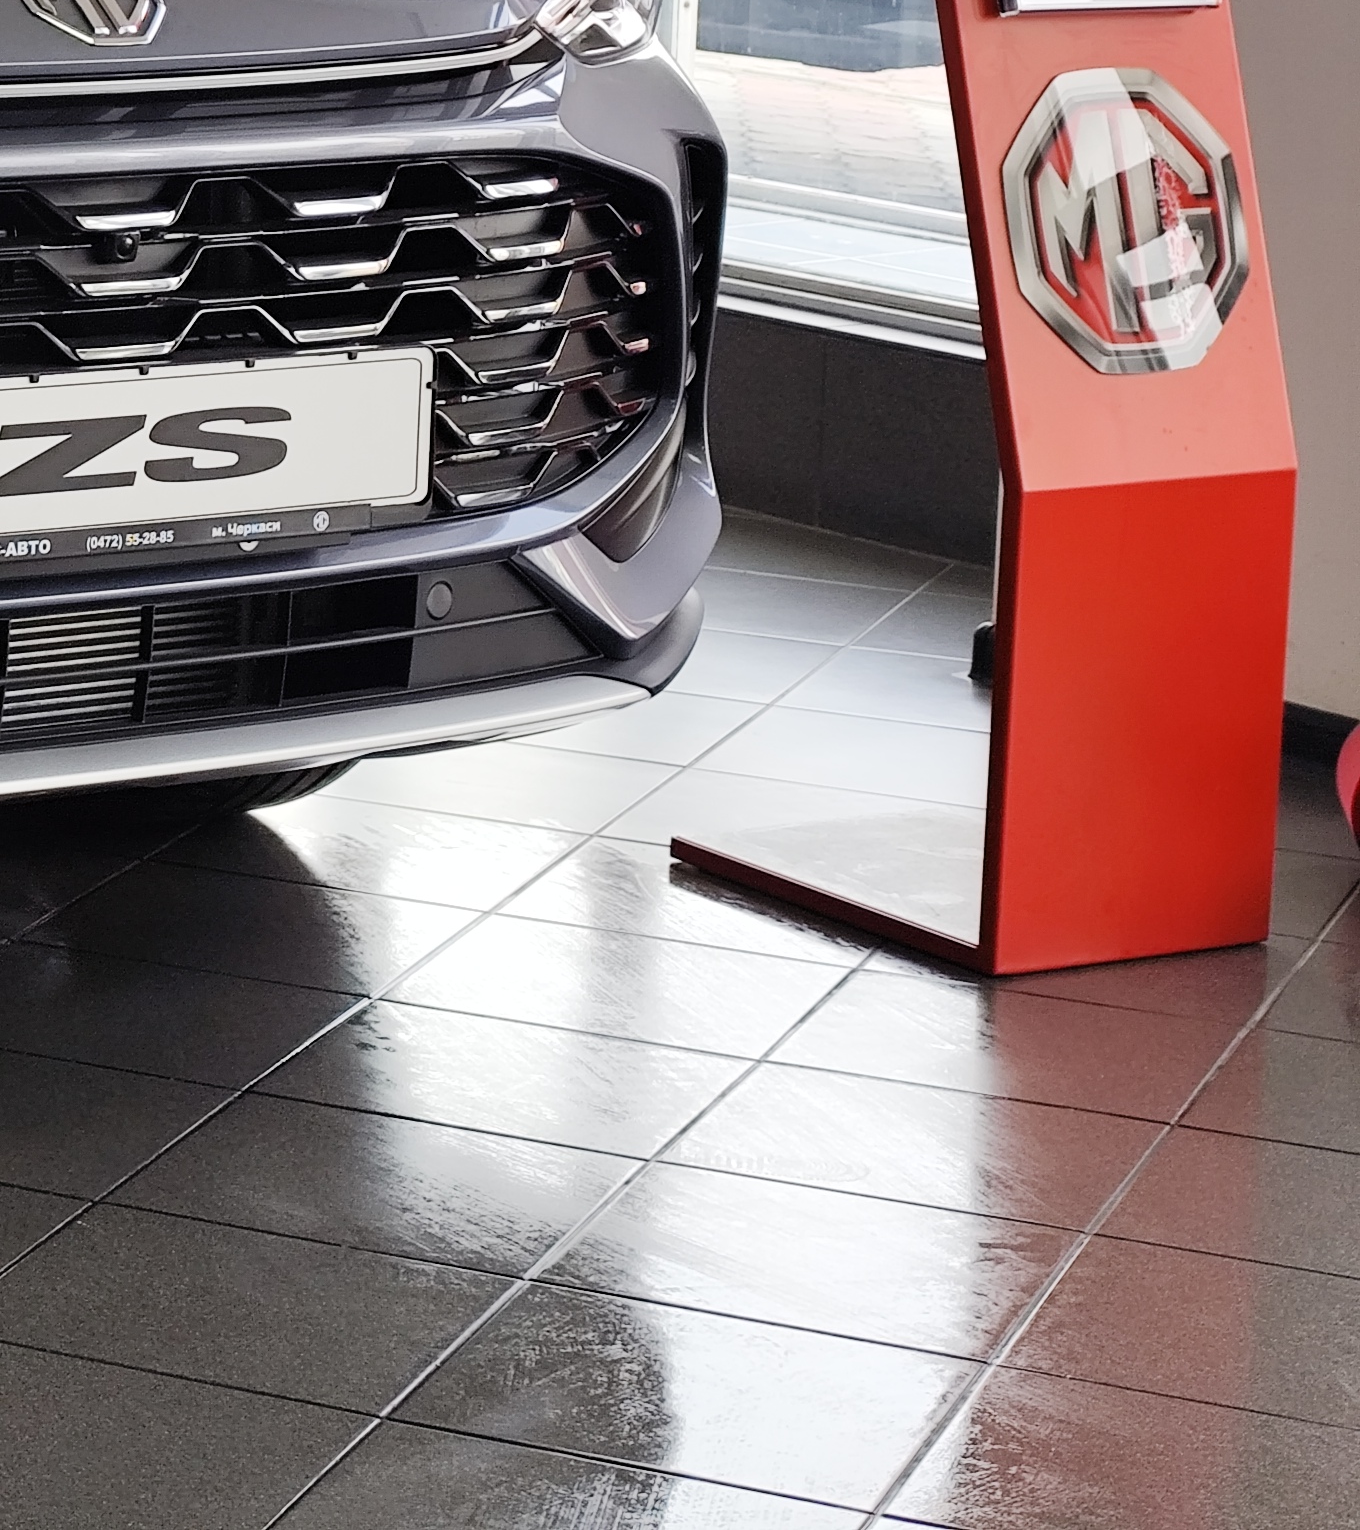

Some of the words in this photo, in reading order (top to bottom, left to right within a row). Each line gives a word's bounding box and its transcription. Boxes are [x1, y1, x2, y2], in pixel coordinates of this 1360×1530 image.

[1030, 104, 1220, 336] MG
[86, 534, 123, 552] (0472)
[125, 530, 175, 546] 55-28-85
